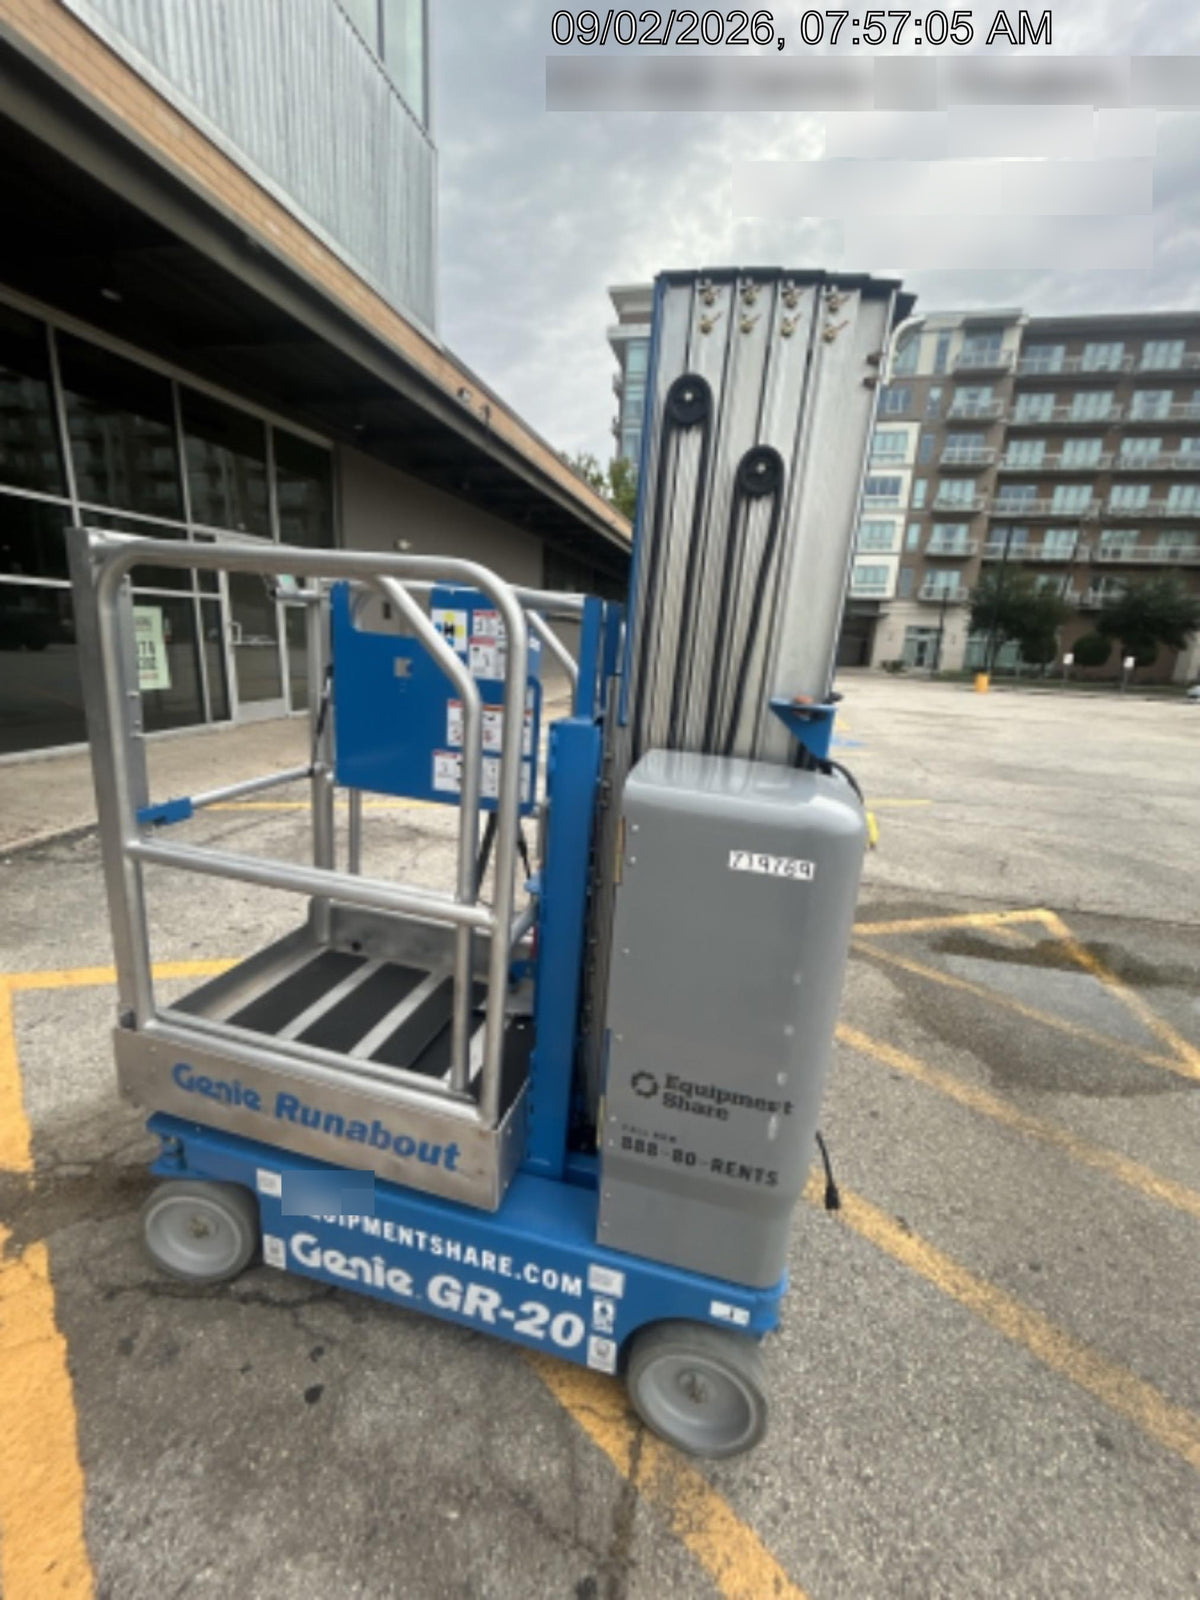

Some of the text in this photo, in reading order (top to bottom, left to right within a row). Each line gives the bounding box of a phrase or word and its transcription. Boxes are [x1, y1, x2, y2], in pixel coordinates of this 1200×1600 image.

[171, 1063, 461, 1172] Genie Runabout
[662, 1091, 729, 1121] Share
[664, 1073, 794, 1115] Equipment
[290, 1232, 414, 1297] Genie
[427, 1274, 586, 1348] GR-20
